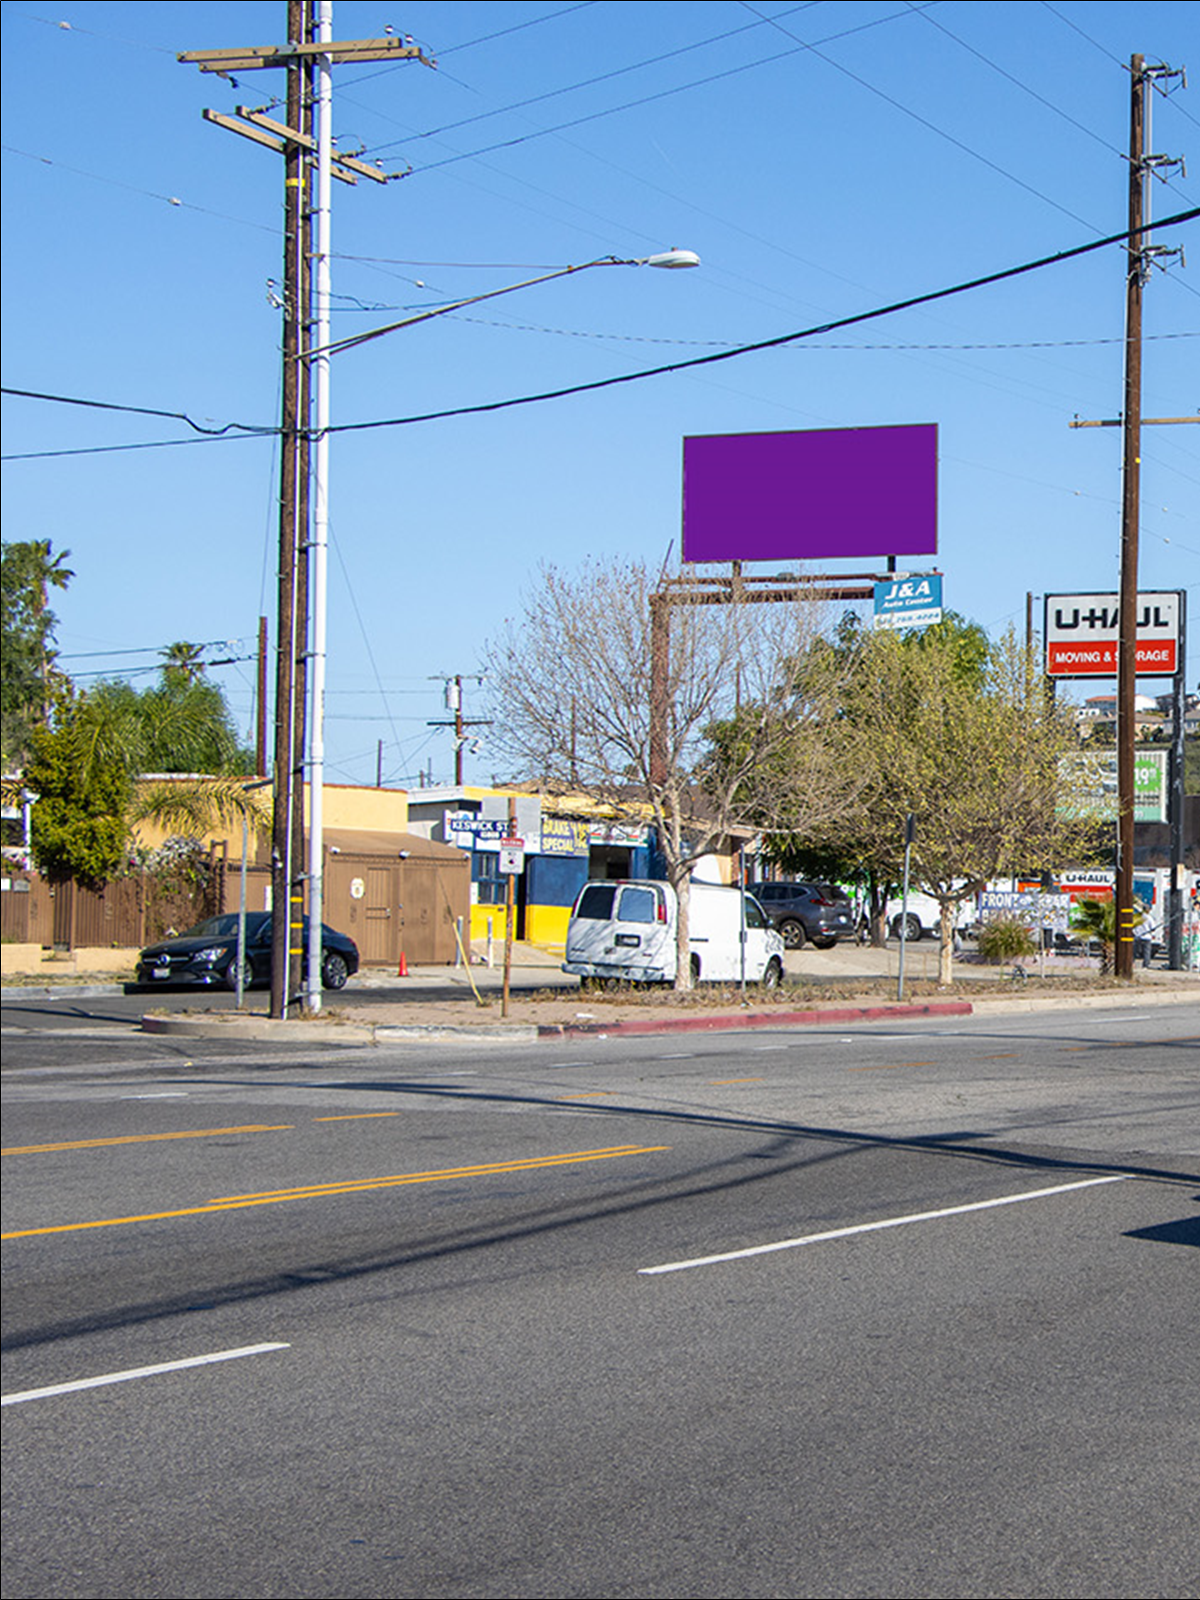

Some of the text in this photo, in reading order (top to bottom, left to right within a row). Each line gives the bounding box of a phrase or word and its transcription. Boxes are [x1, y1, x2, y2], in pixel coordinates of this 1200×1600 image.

[885, 580, 931, 600] J&A
[905, 597, 934, 606] Center
[1055, 650, 1169, 663] MOVING & SRAGE
[452, 820, 509, 831] KESWICK ST
[542, 837, 574, 852] SPECIAL
[981, 892, 1019, 907] FRONT
